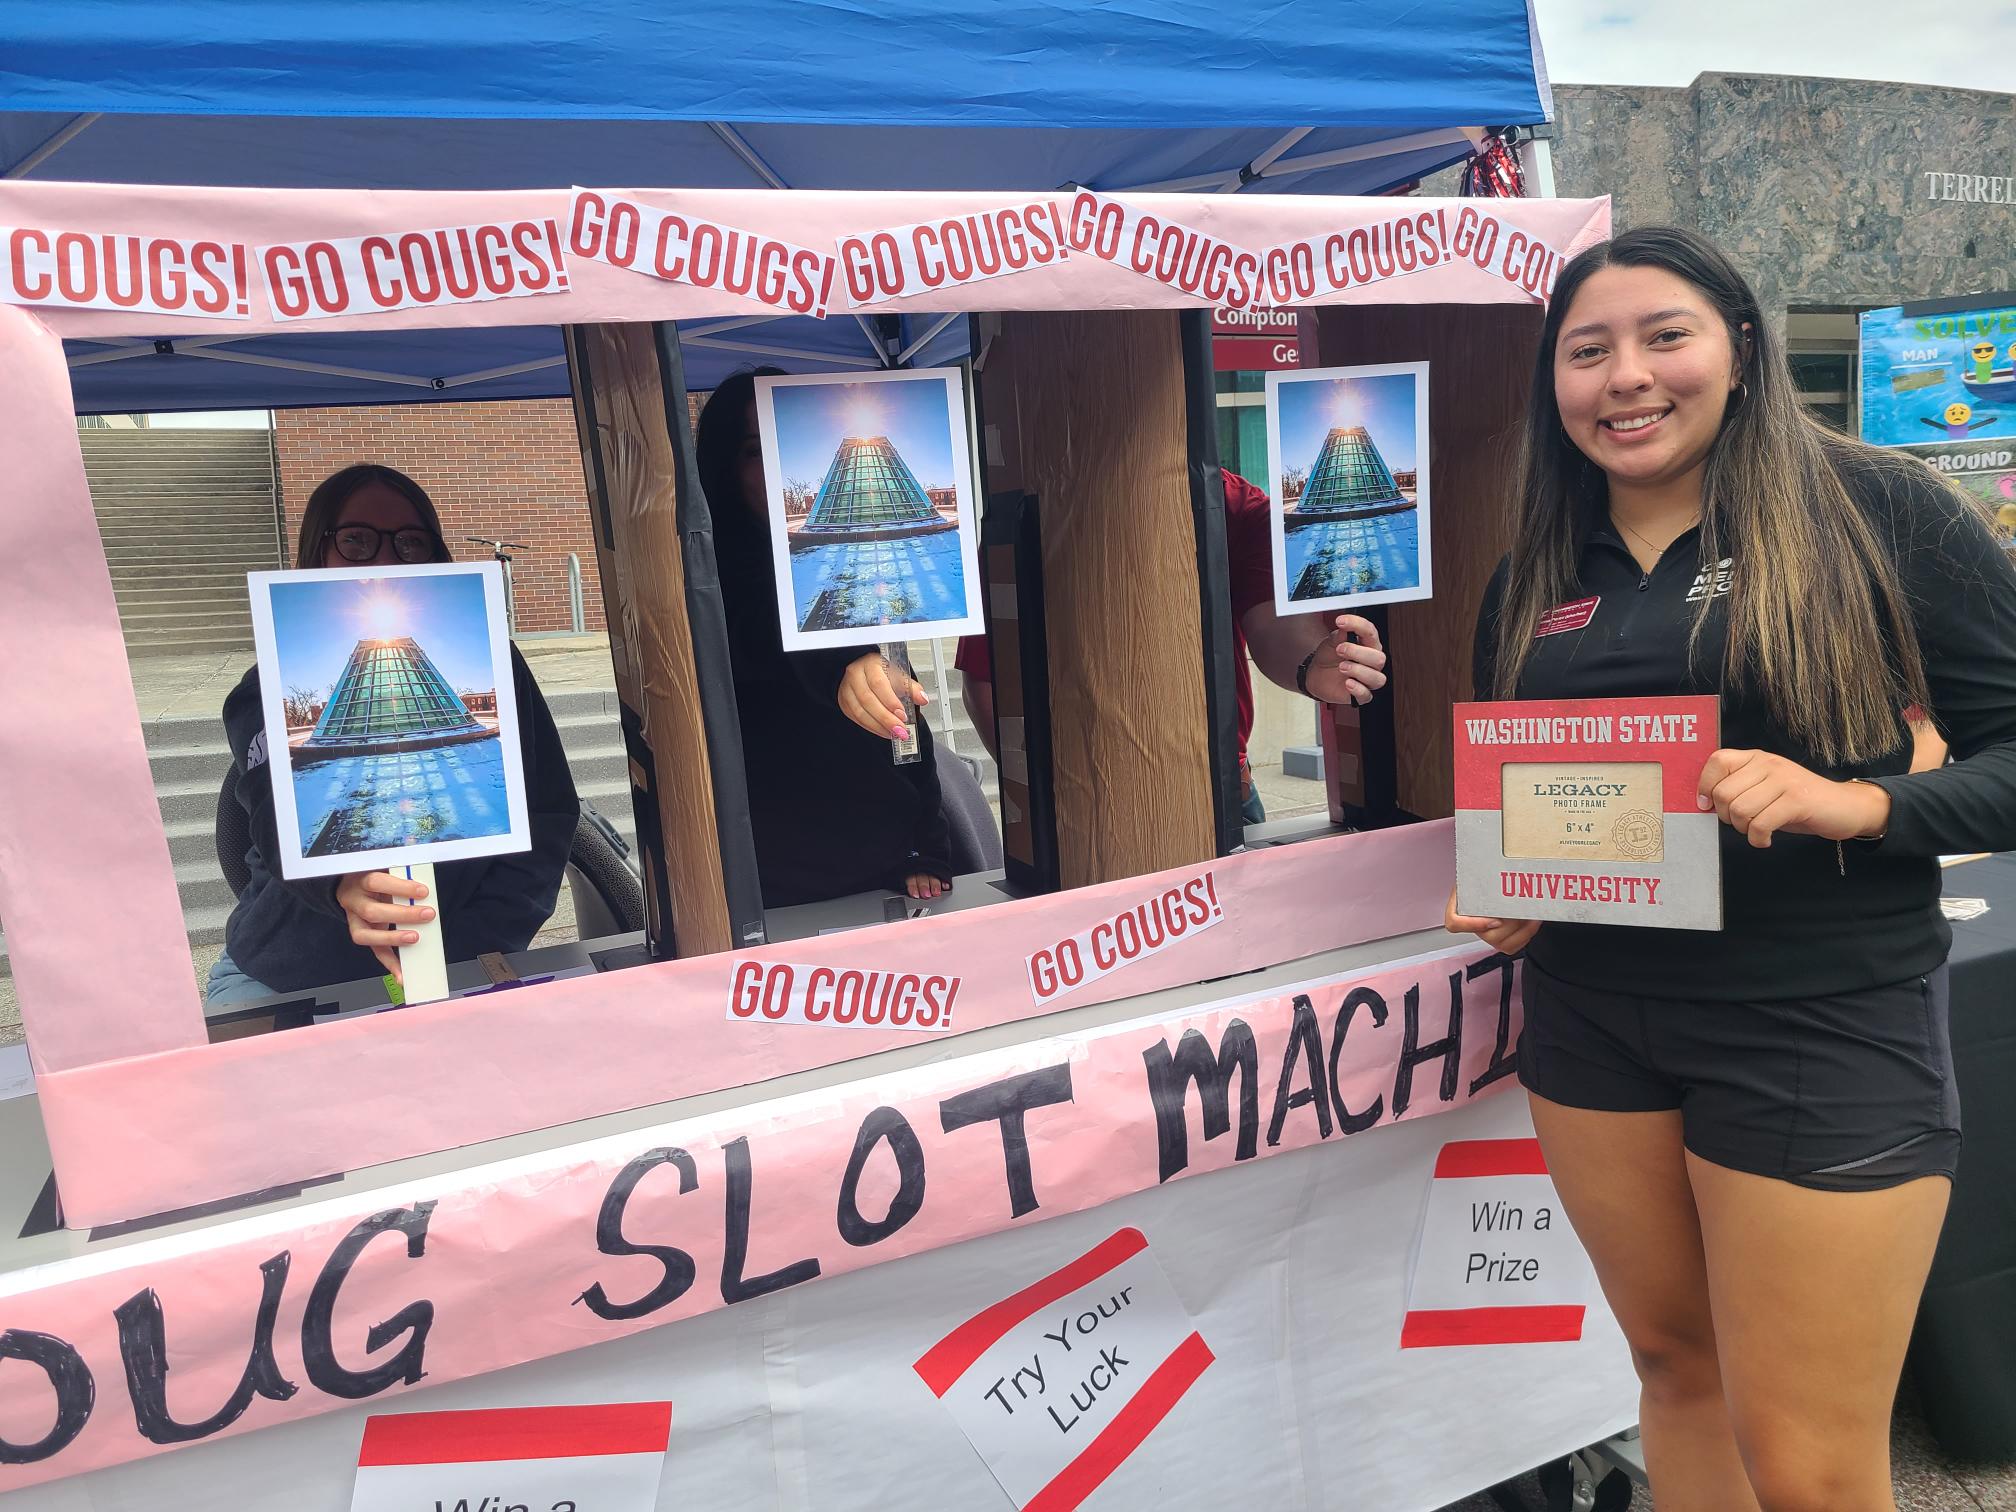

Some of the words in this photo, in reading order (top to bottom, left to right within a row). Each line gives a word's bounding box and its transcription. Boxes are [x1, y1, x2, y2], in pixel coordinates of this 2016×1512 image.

[264, 242, 349, 317] GO
[361, 219, 568, 306] COUGS!
[570, 192, 640, 267] GO
[655, 215, 835, 318] COUGS!
[842, 234, 904, 301] GO
[912, 201, 1068, 287] COUGS!
[1069, 193, 1124, 260] GO
[1131, 216, 1263, 313] COUGS!
[1267, 247, 1315, 303] GO
[1326, 208, 1450, 289] COUGS!
[1453, 206, 1499, 269] GO
[10, 228, 248, 314] COUGS!
[1213, 307, 1297, 331] Compton
[1915, 309, 2016, 342] SOLVE
[1273, 344, 1299, 363] Ge
[1902, 346, 1939, 361] MAN
[1465, 716, 1612, 745] WASHINGTON
[1619, 714, 1698, 743] STATE
[1533, 784, 1627, 797] LEGACY
[1553, 799, 1578, 808] PHOTO
[1580, 799, 1607, 808] FRAME
[1501, 872, 1661, 904] UNIVERSITY
[1031, 938, 1083, 998] GO
[1091, 871, 1222, 971] COUGS!
[732, 961, 793, 1019] GO
[804, 967, 961, 1028] COUGS!
[571, 1058, 1074, 1322] SLOT
[1472, 1201, 1523, 1233] Win
[1534, 1208, 1551, 1231] a
[1466, 1252, 1539, 1284] Prize
[984, 1353, 1046, 1415] Try
[1043, 1286, 1132, 1352] Your
[1047, 1345, 1130, 1434] Luck
